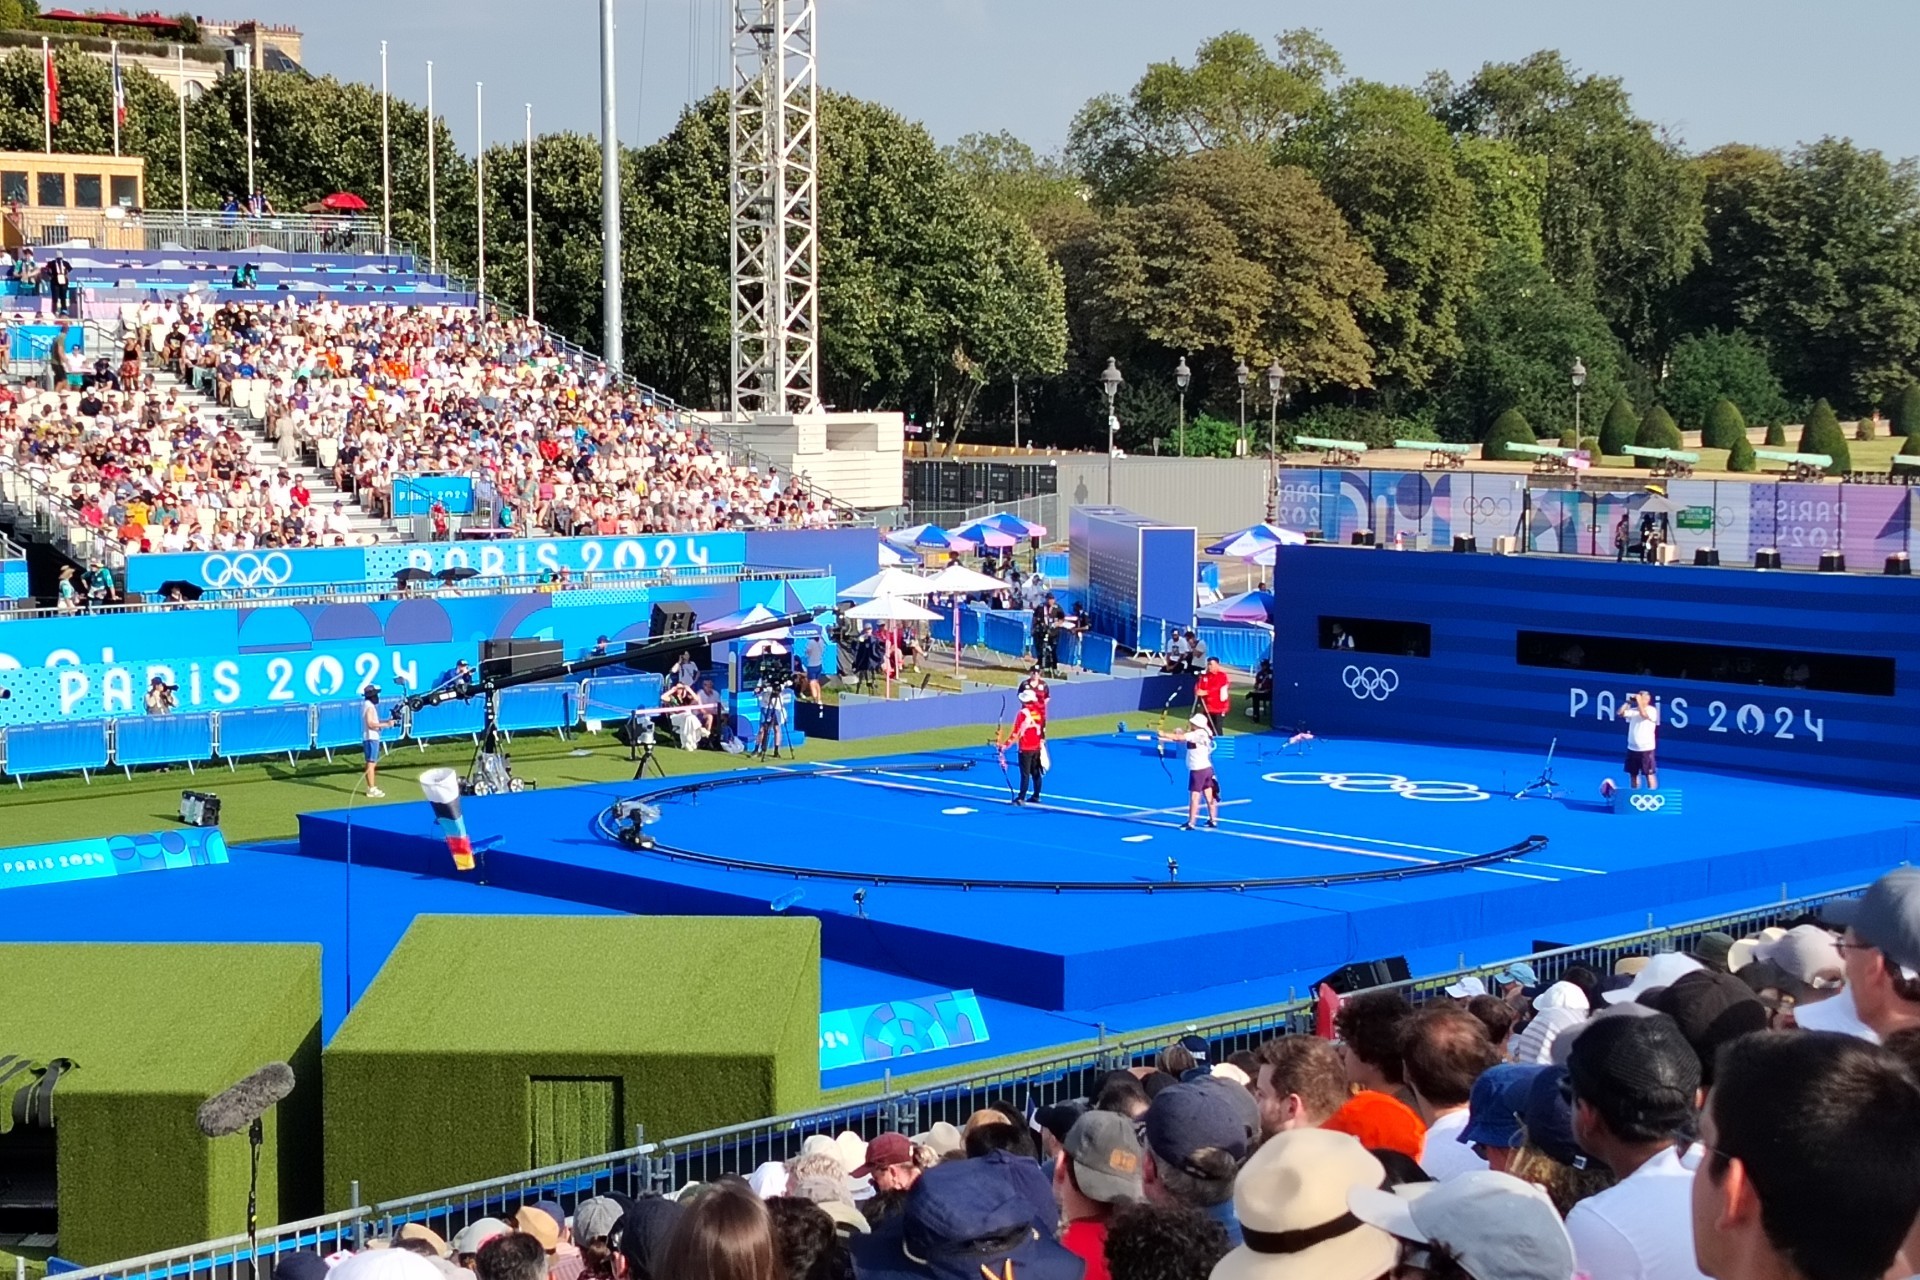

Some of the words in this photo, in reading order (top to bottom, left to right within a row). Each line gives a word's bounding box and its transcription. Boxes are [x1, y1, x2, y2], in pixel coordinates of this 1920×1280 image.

[581, 538, 708, 574] 2024
[266, 651, 418, 700] 2024
[1708, 701, 1824, 742] 2024
[59, 852, 105, 868] 2024
[819, 1030, 849, 1048] 24
